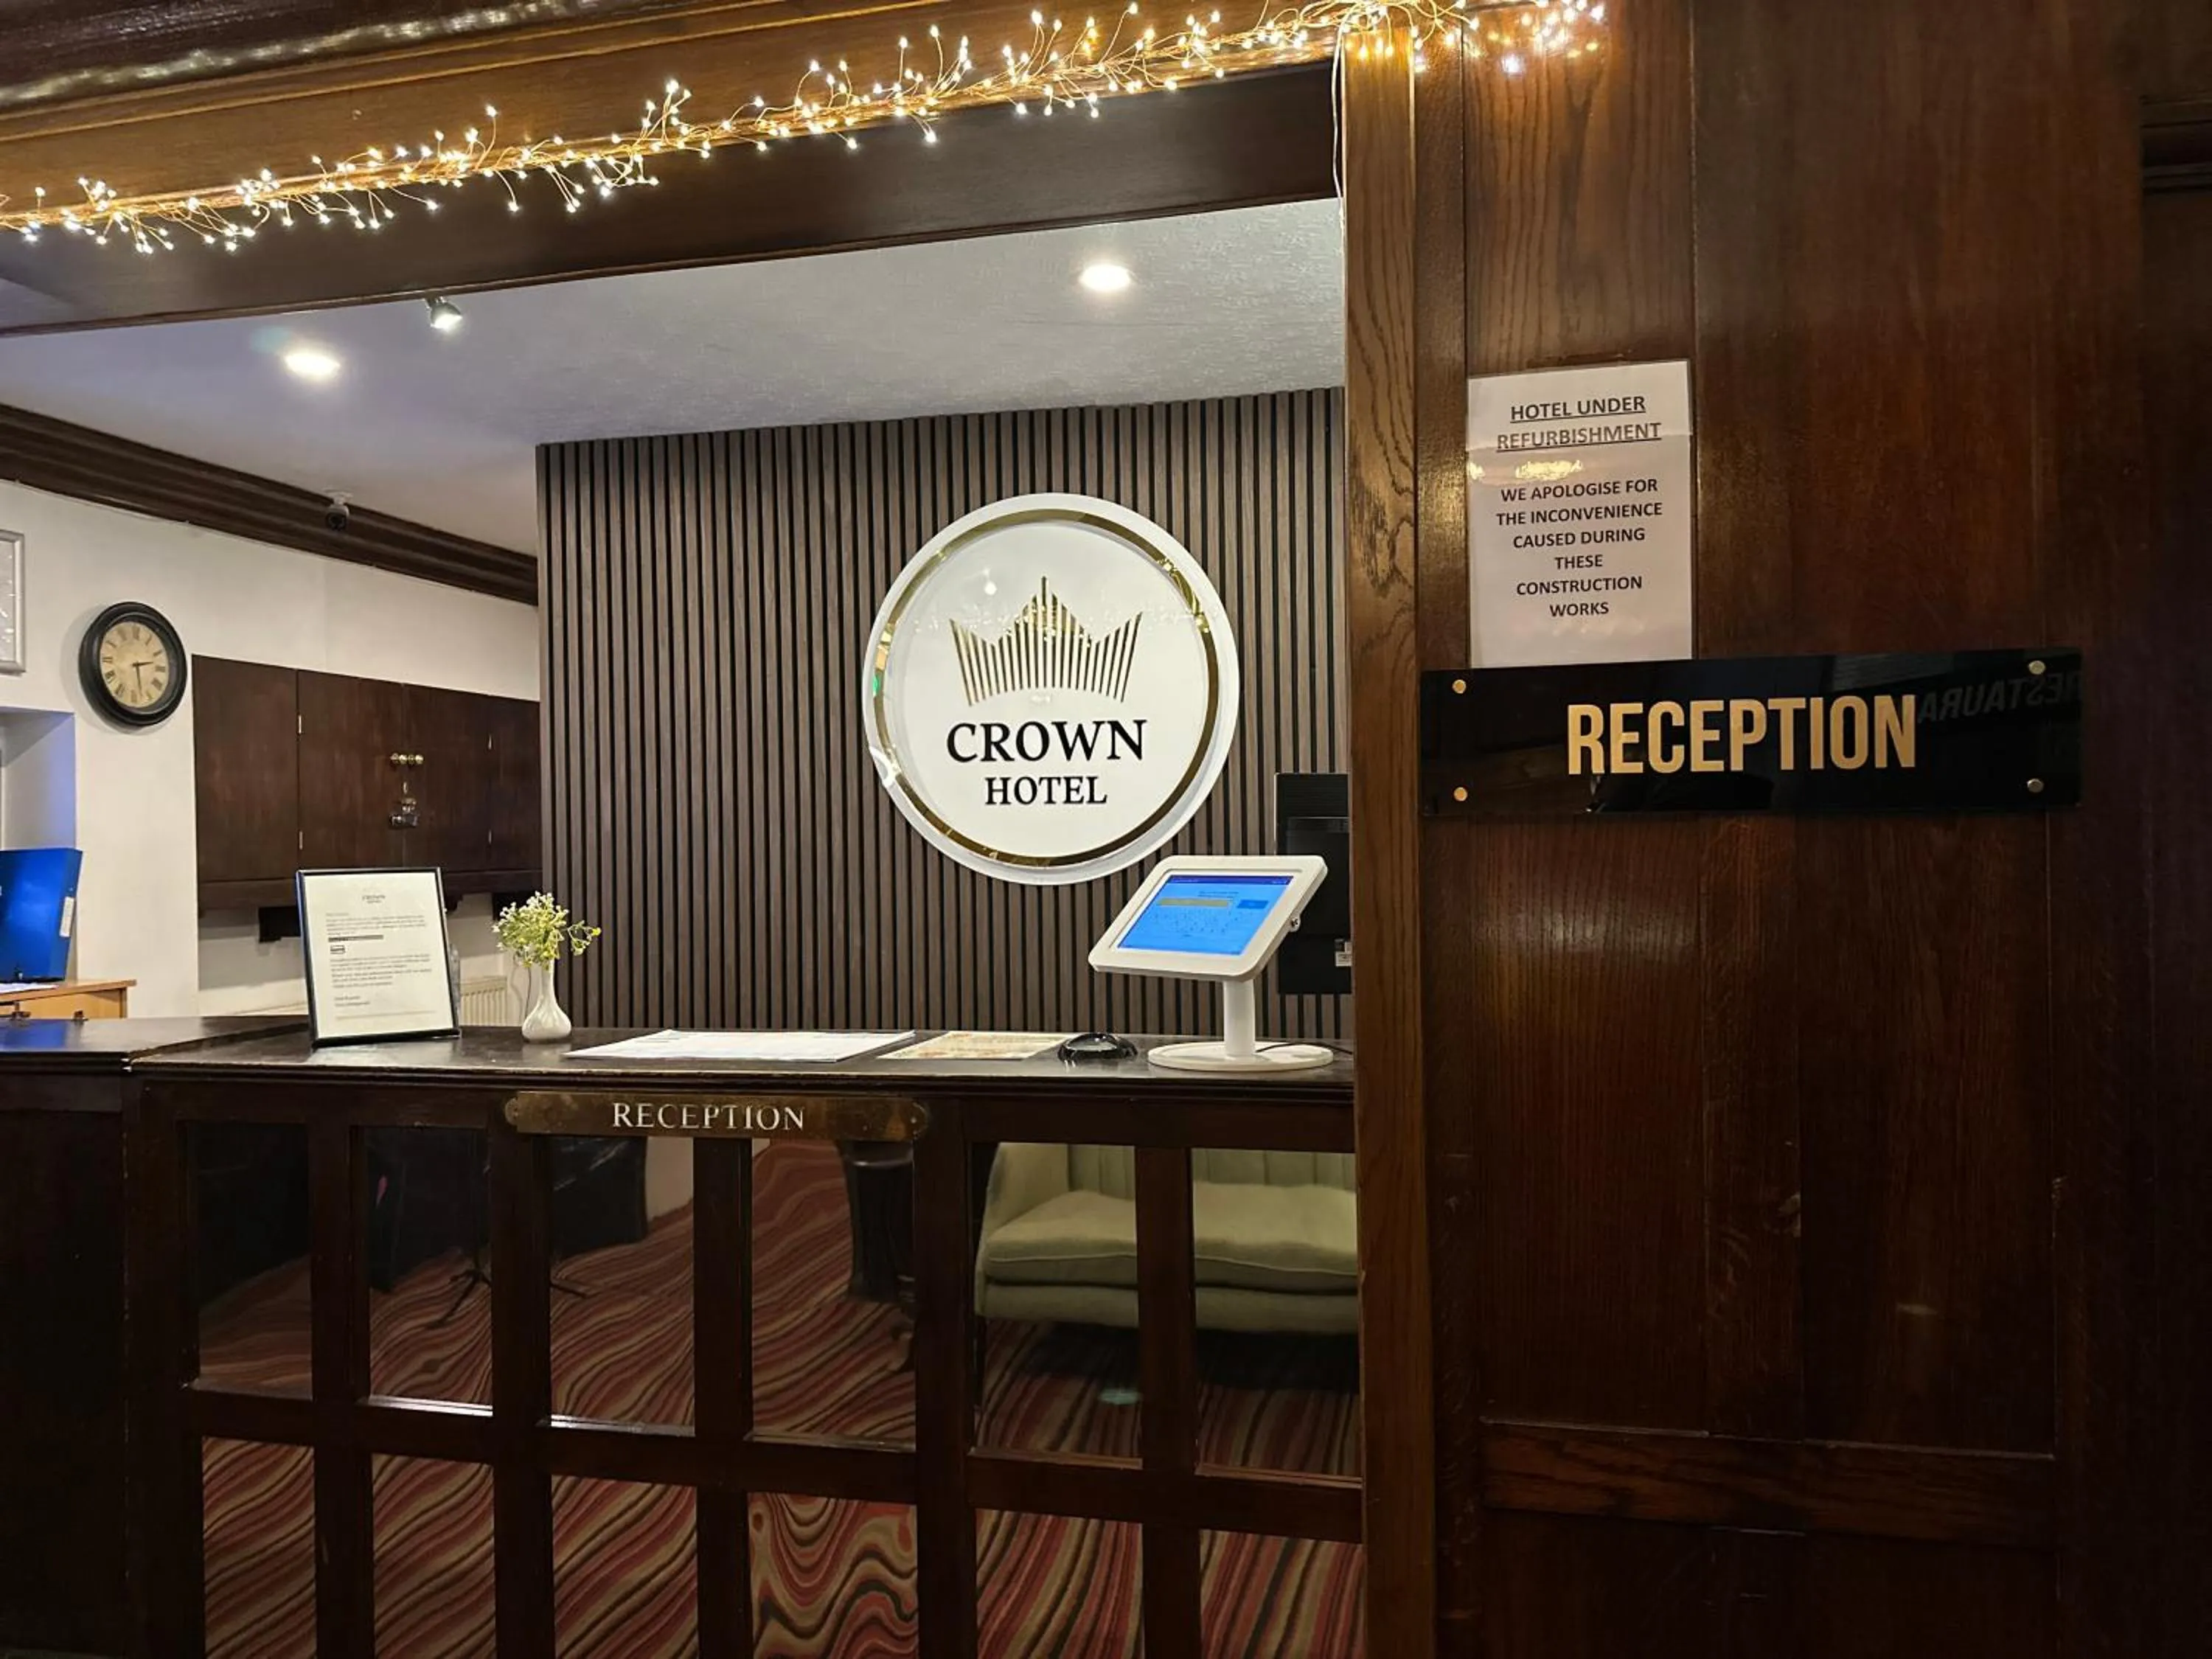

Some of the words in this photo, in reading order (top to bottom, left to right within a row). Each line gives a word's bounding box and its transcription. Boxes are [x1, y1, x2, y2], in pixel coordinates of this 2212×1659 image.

[1510, 402, 1571, 421] HOTEL
[1577, 396, 1646, 416] UNDER
[1496, 422, 1662, 451] REFURBISHMENT
[1500, 487, 1526, 502] WE
[1531, 481, 1621, 501] APOLOGISE
[1625, 479, 1658, 493] FOR
[1496, 511, 1526, 526] THE
[1531, 502, 1663, 524] INCONVENIENCE
[1513, 532, 1576, 549] CAUSED
[1580, 527, 1646, 545] DURING
[1554, 554, 1604, 570] THESE
[1517, 576, 1643, 596] CONSTRUCTION
[1550, 602, 1610, 617] WORKS
[947, 719, 1147, 763] CROWN
[1568, 695, 1916, 775] RECEPTION
[985, 776, 1107, 805] HOTEL
[612, 1102, 804, 1130] RECEPTION
